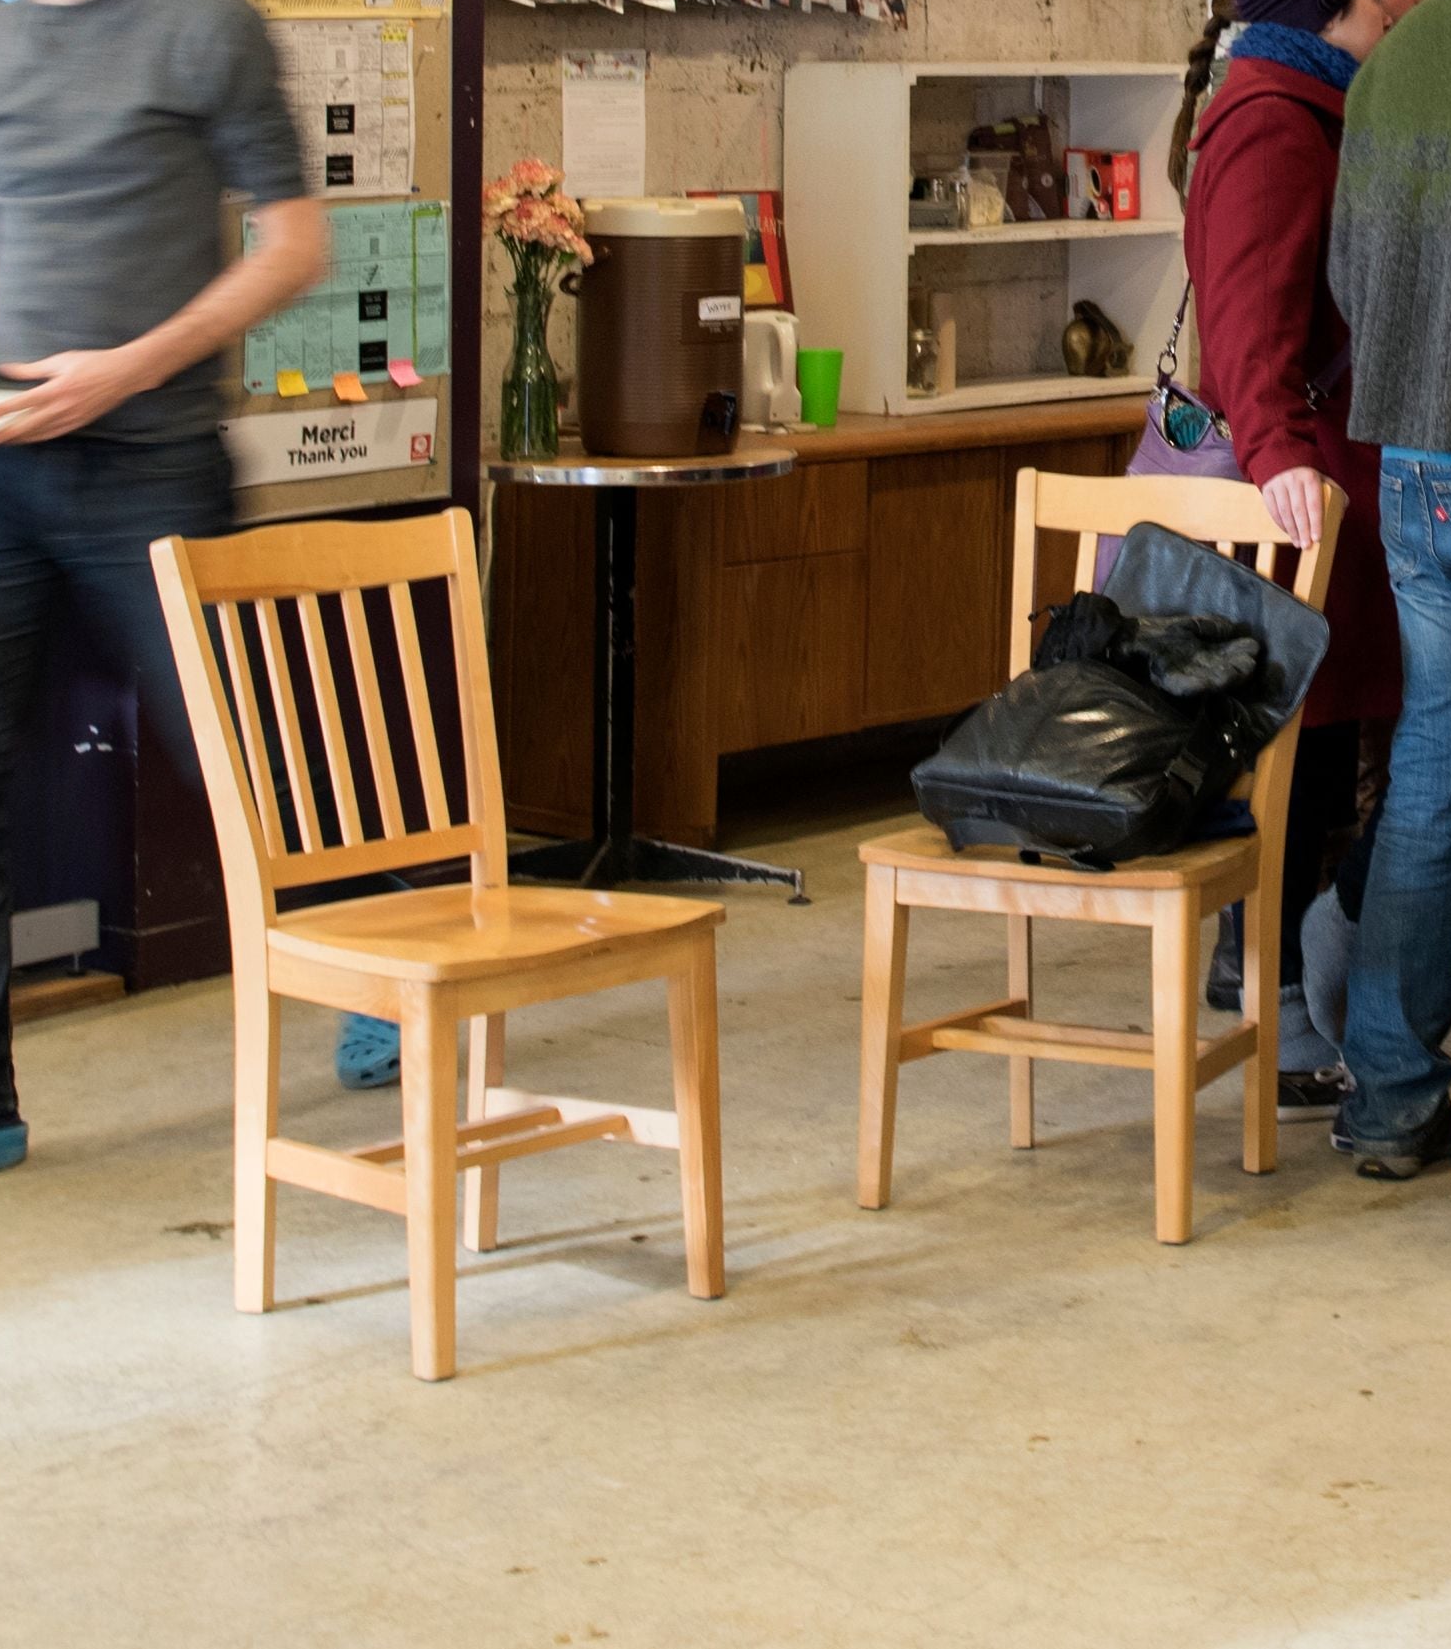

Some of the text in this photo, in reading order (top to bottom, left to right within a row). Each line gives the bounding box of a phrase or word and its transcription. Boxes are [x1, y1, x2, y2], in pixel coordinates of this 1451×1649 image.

[301, 420, 356, 446] Merci
[287, 444, 368, 467] Thank you
